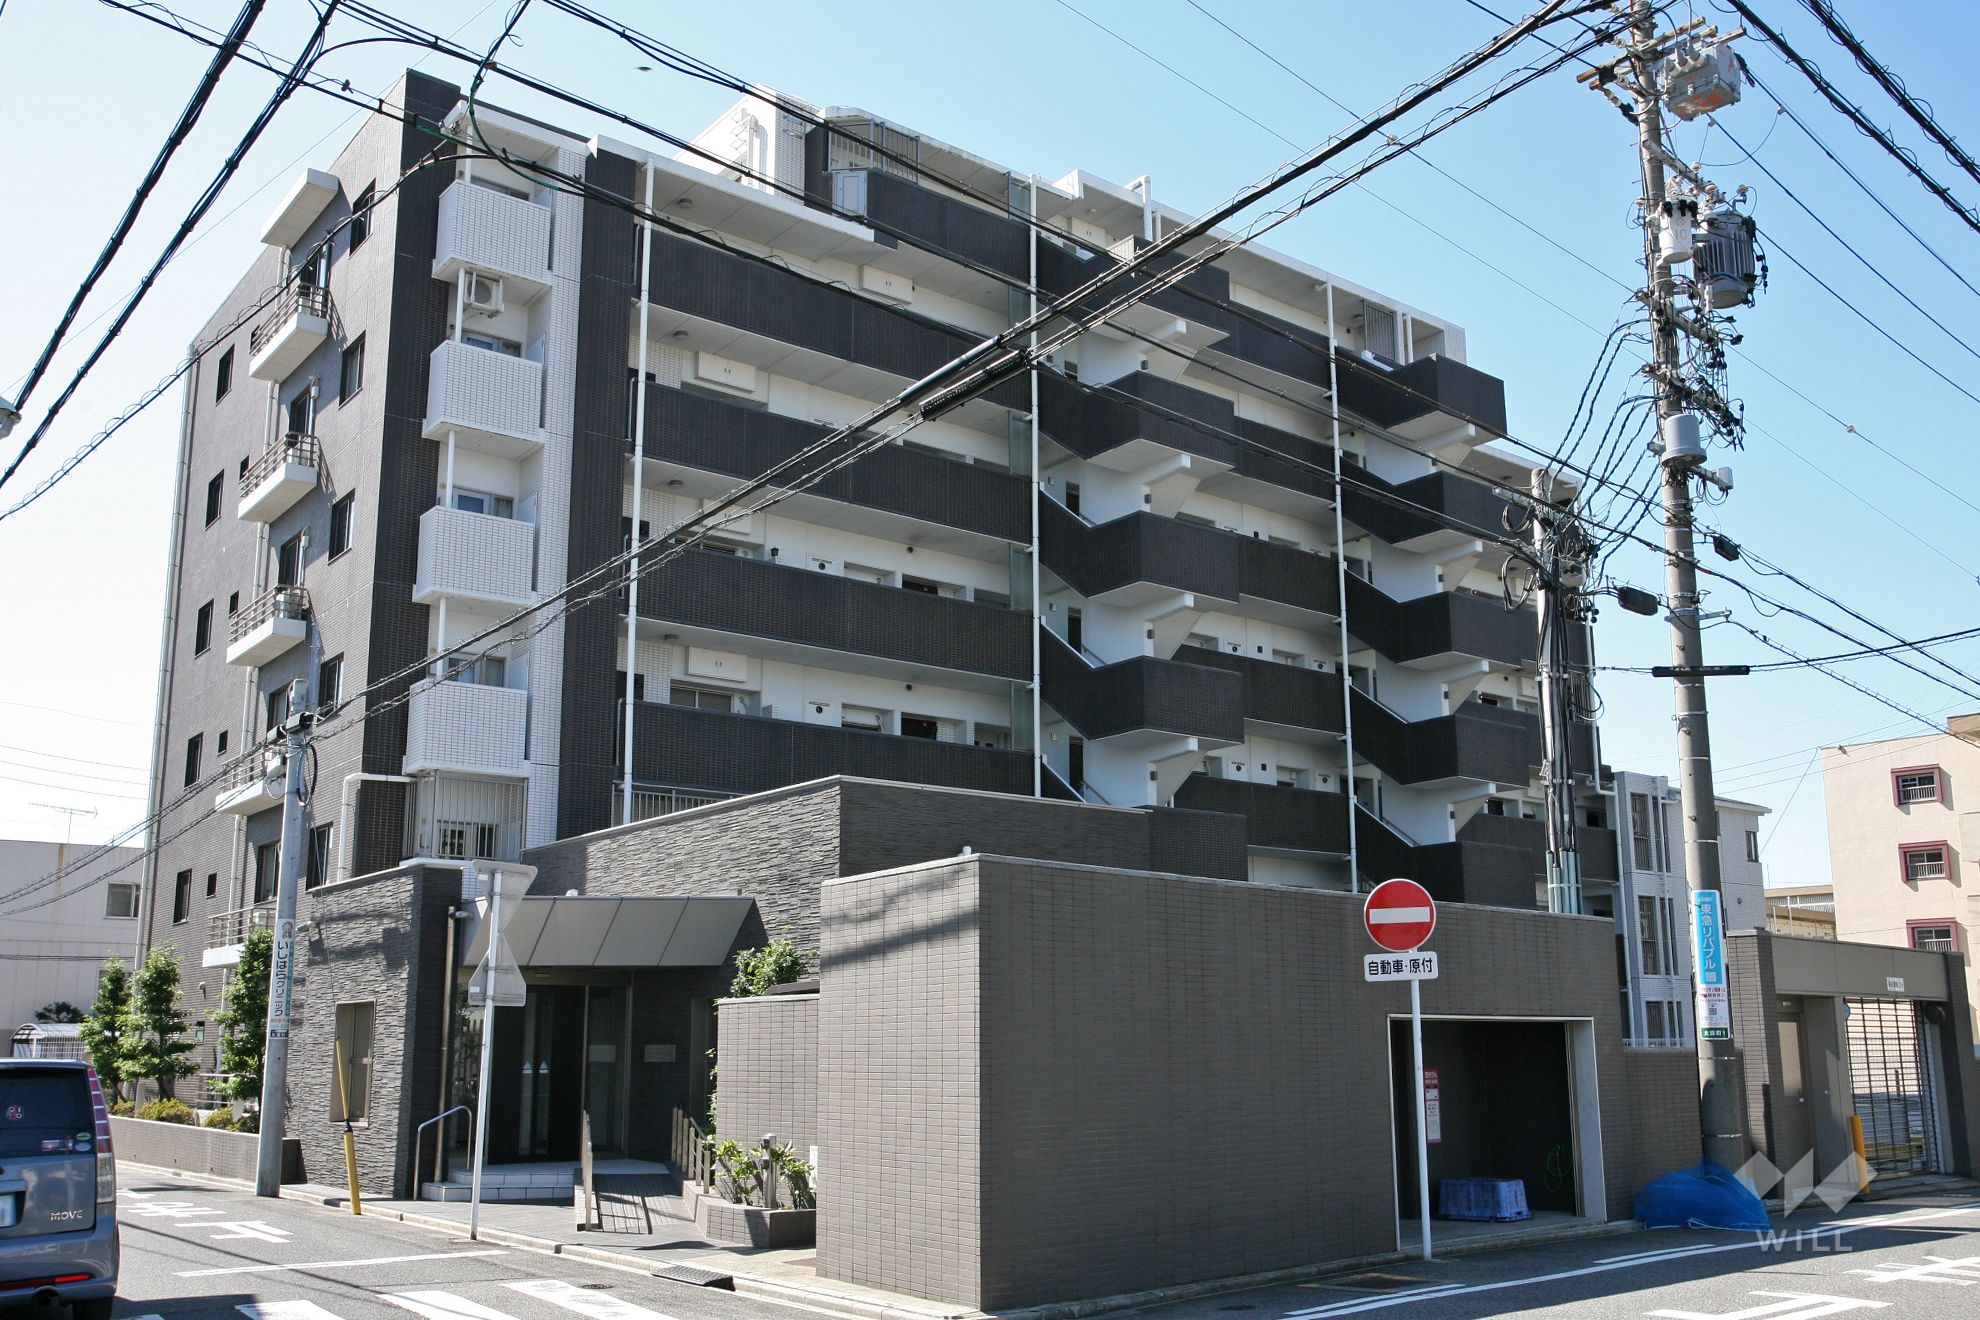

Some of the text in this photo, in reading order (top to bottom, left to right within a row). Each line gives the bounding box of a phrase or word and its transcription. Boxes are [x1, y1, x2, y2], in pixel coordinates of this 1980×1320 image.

[1701, 904, 1716, 969] 東急リバブル
[275, 941, 288, 1016] いしはらクリニック
[1368, 958, 1432, 975] 自動車・原付
[50, 1210, 83, 1221] MOVE
